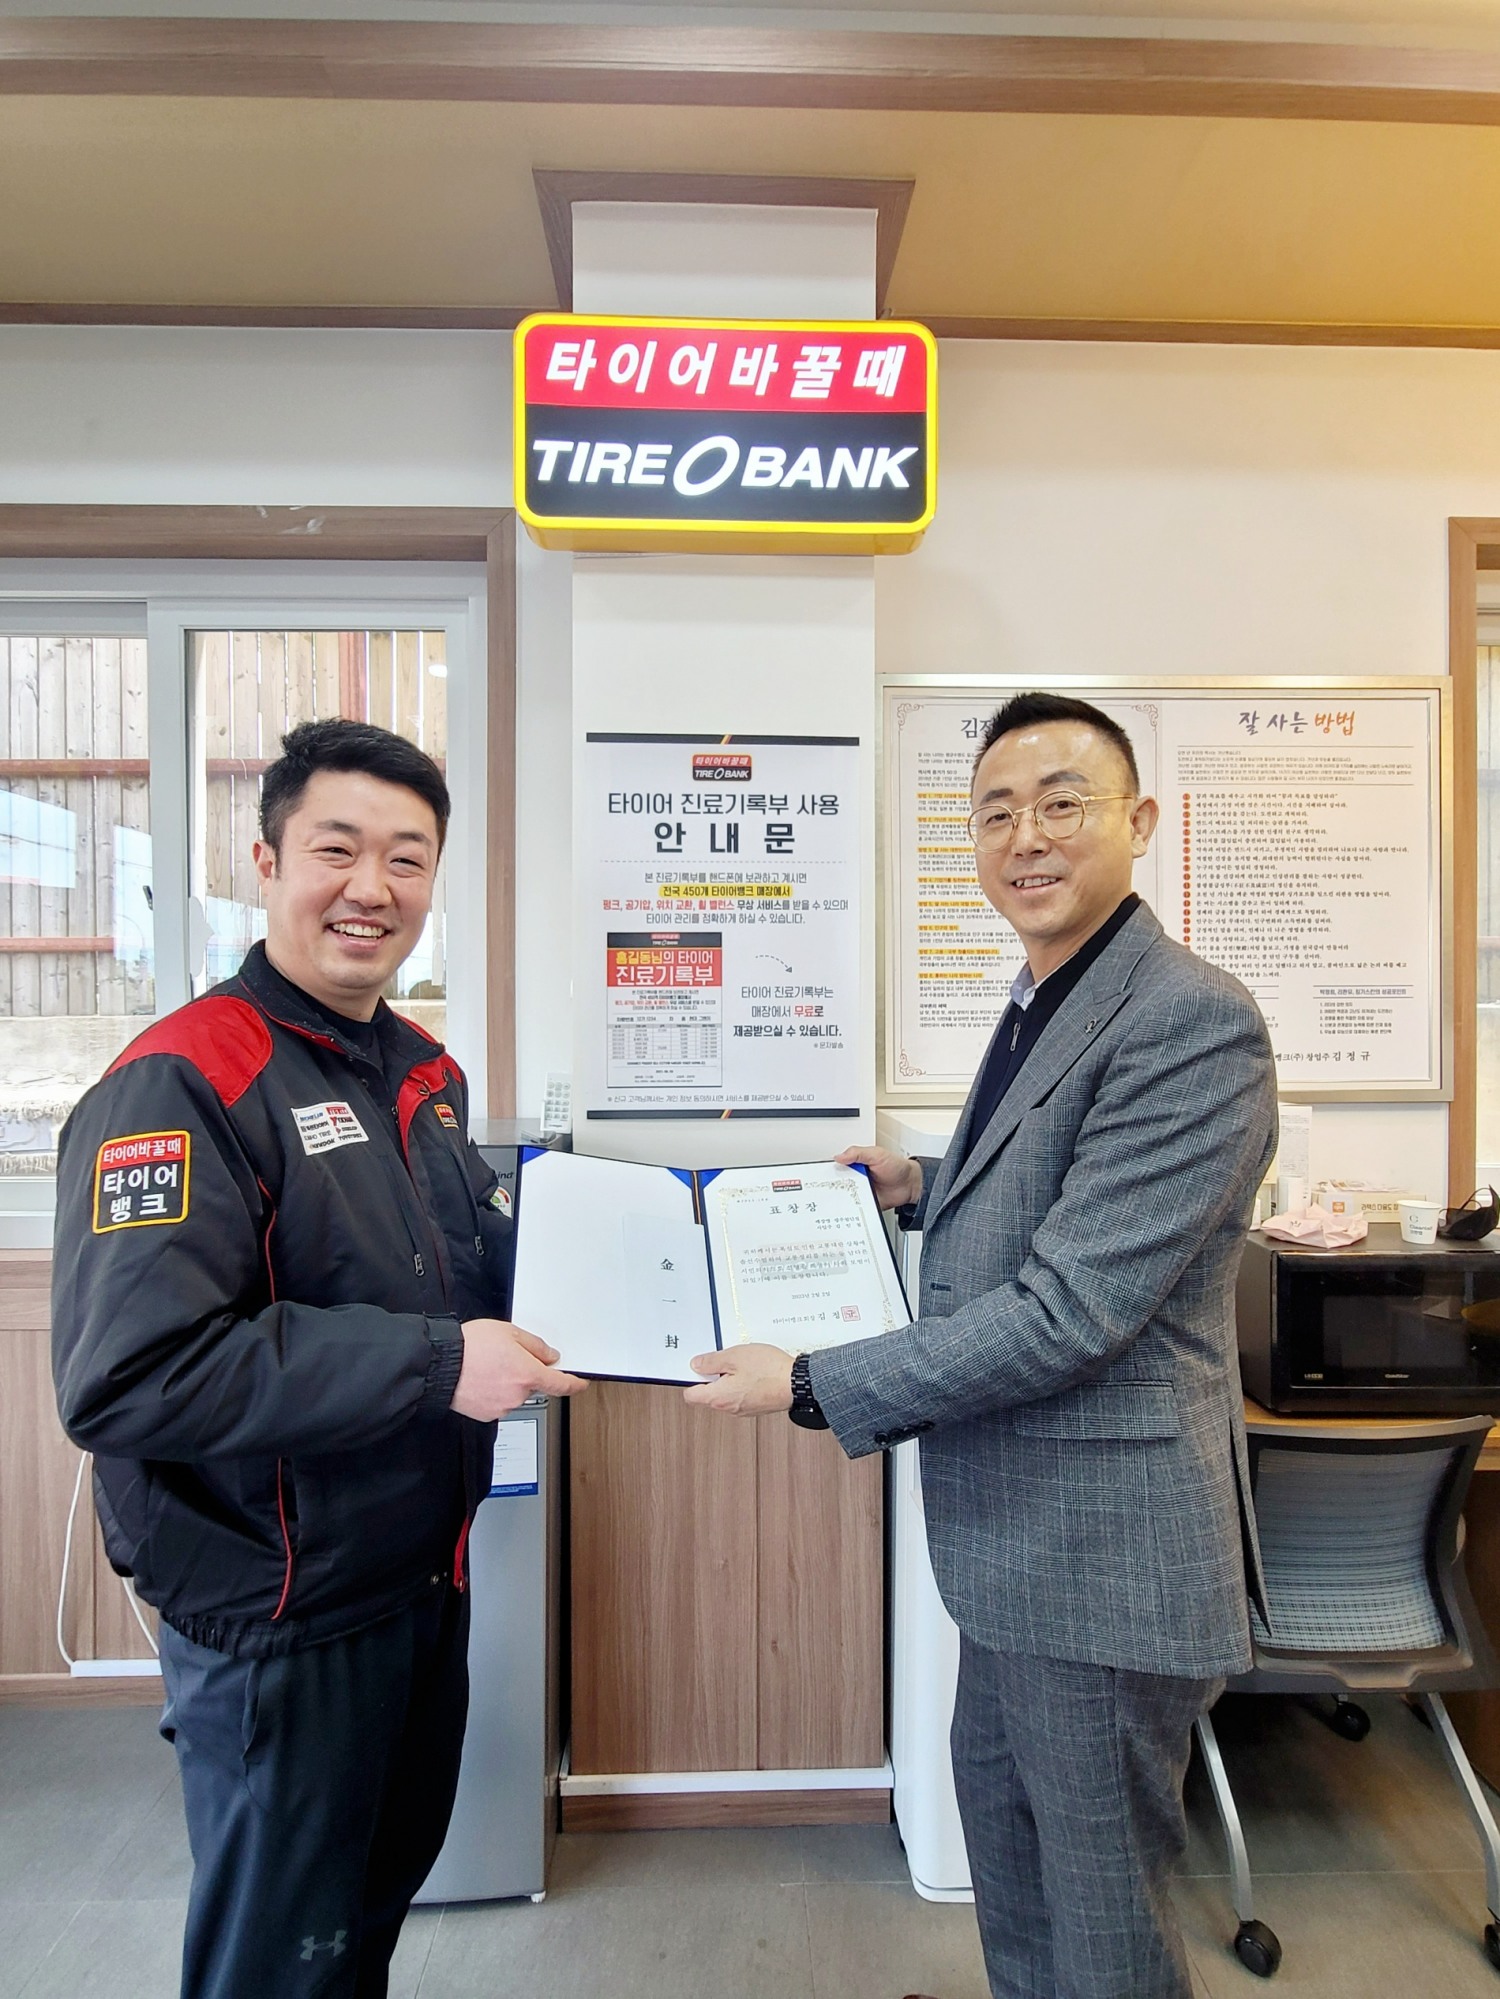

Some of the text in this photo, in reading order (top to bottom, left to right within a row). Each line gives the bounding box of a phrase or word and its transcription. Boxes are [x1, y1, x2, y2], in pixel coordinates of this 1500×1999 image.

[741, 446, 919, 488] BANK
[1237, 710, 1354, 736] 잘 사는 방법
[608, 793, 838, 815] 타이어 진료기록부 사용
[644, 872, 807, 885] 본 진료기록부를 핸드폰에 보관하고 계시면
[663, 886, 790, 896] 전국 450개 타이어뱅크 매장에서
[603, 899, 848, 911] 펑크, 공기압, 위치 교환, 휠 밸런스 무상 서비스를 받을 수 있으며
[645, 913, 807, 923] 타이어 관리를 정확하게 하실 수 있습니다.
[616, 951, 715, 964] 홍길동님의 타이어
[616, 967, 714, 986] 진료기록부
[741, 986, 834, 998] 타이어 진료기록부는
[751, 1005, 824, 1017] 매장에서 무료로
[734, 1025, 842, 1037] 제공받으실 수 있습니다.
[103, 1137, 181, 1164] 타이어바꿀때
[103, 1163, 178, 1195] 타이어
